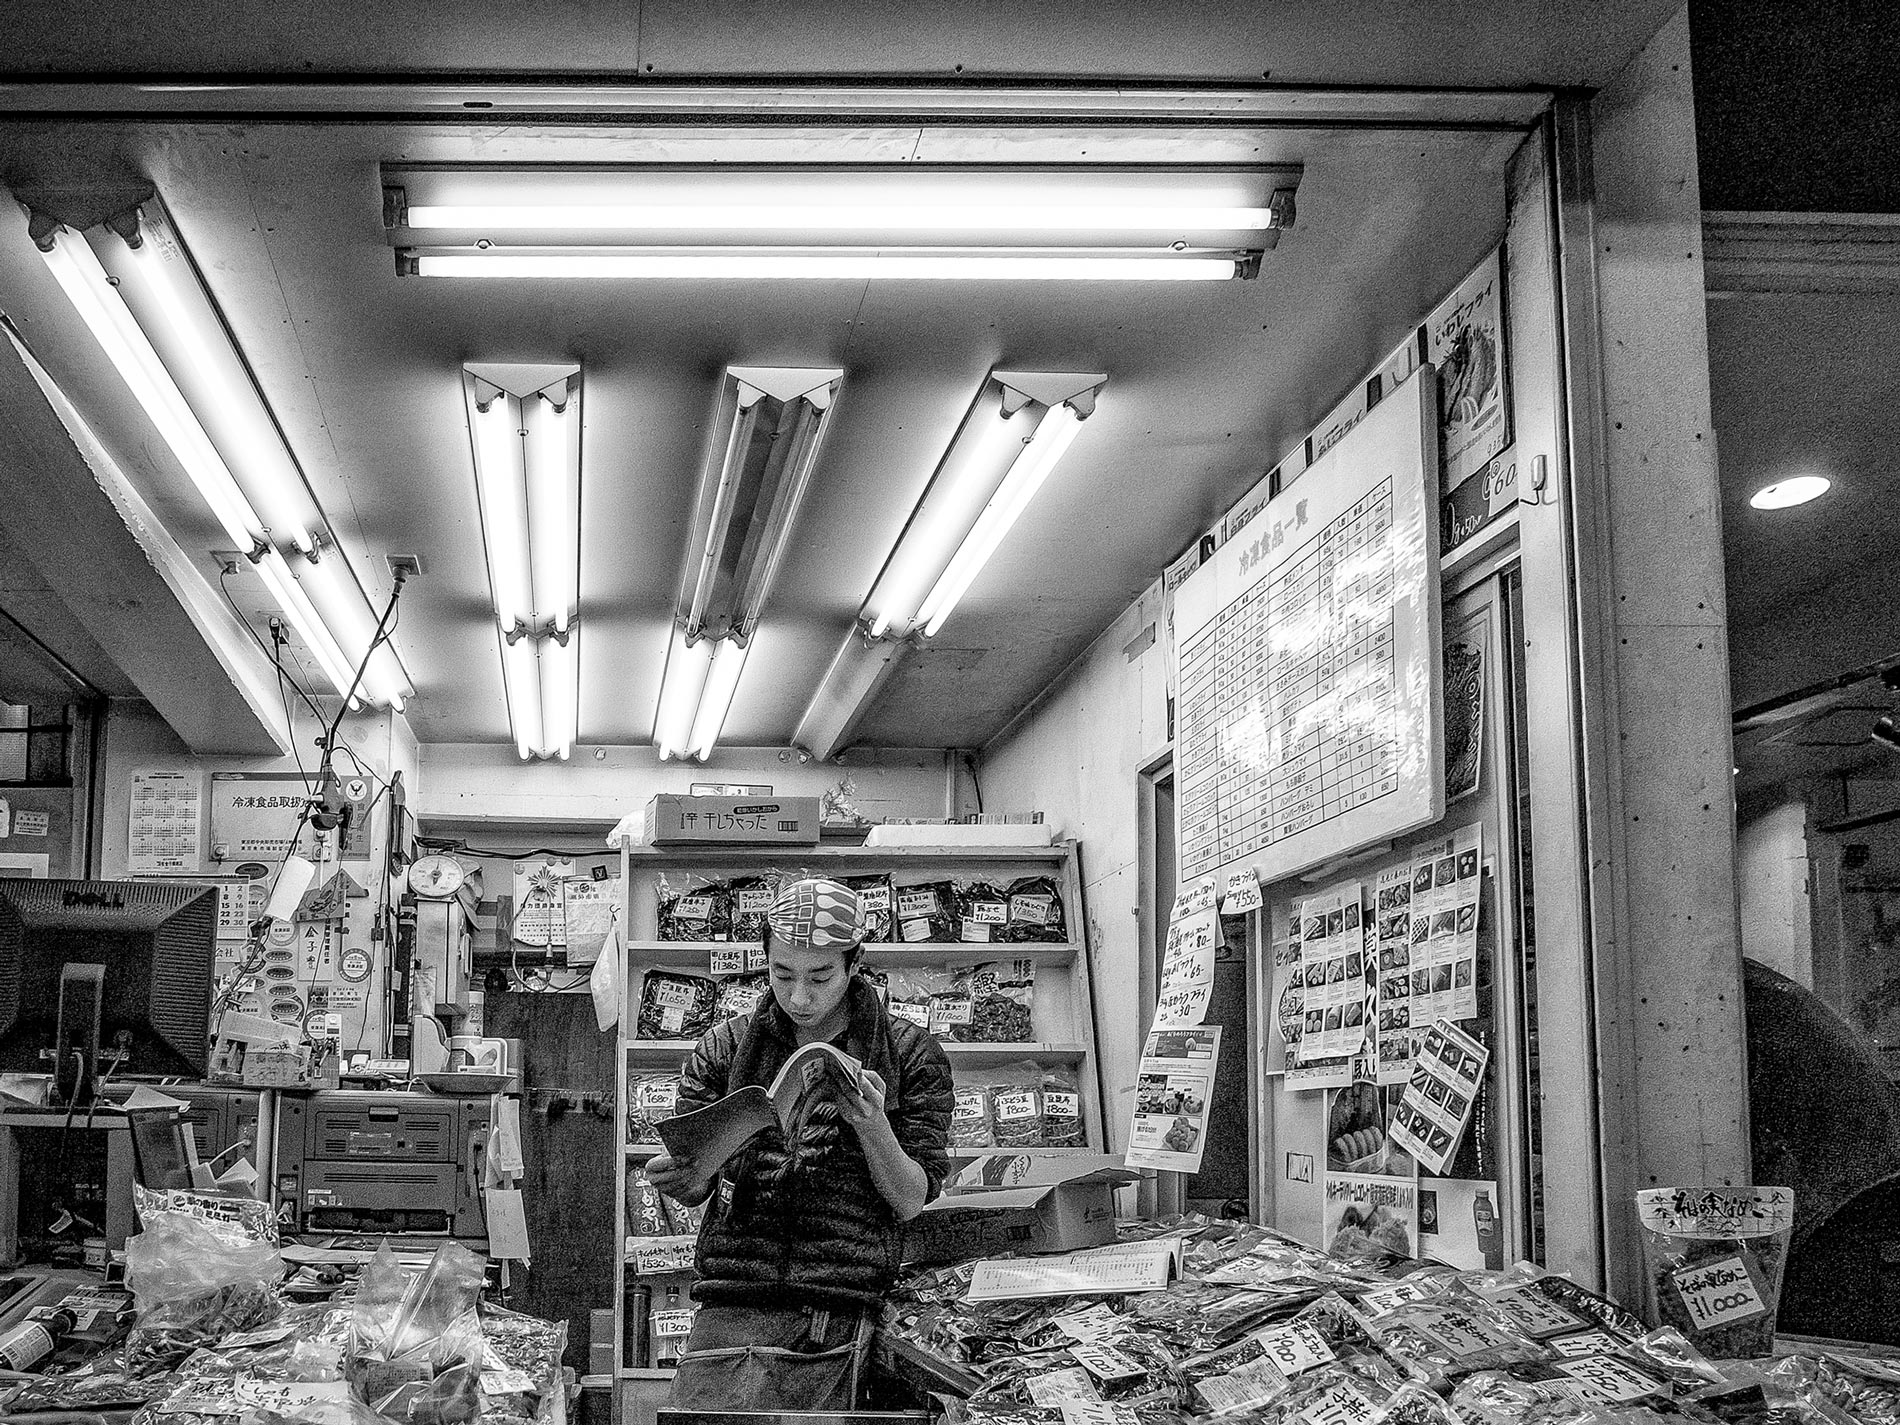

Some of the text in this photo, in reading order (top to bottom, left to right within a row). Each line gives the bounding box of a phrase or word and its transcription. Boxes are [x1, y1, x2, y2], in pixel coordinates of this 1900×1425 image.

[1371, 482, 1386, 503] ケース
[1239, 498, 1308, 577] 冷凍食品一覧
[703, 812, 767, 831] 干しちゃった
[741, 892, 773, 900] きゃらぶき
[975, 913, 1005, 922] ¥1200-
[712, 961, 741, 972] ¥1380-
[1000, 1095, 1030, 1105] ぶどう豆
[1047, 1094, 1072, 1105] 豆昆布
[1006, 1105, 1031, 1115] ¥800-
[1046, 1104, 1073, 1115] ¥800-
[658, 1322, 690, 1333] ¥1300-
[1267, 1332, 1297, 1366] ¥900-
[1570, 1362, 1622, 1396] ¥950-
